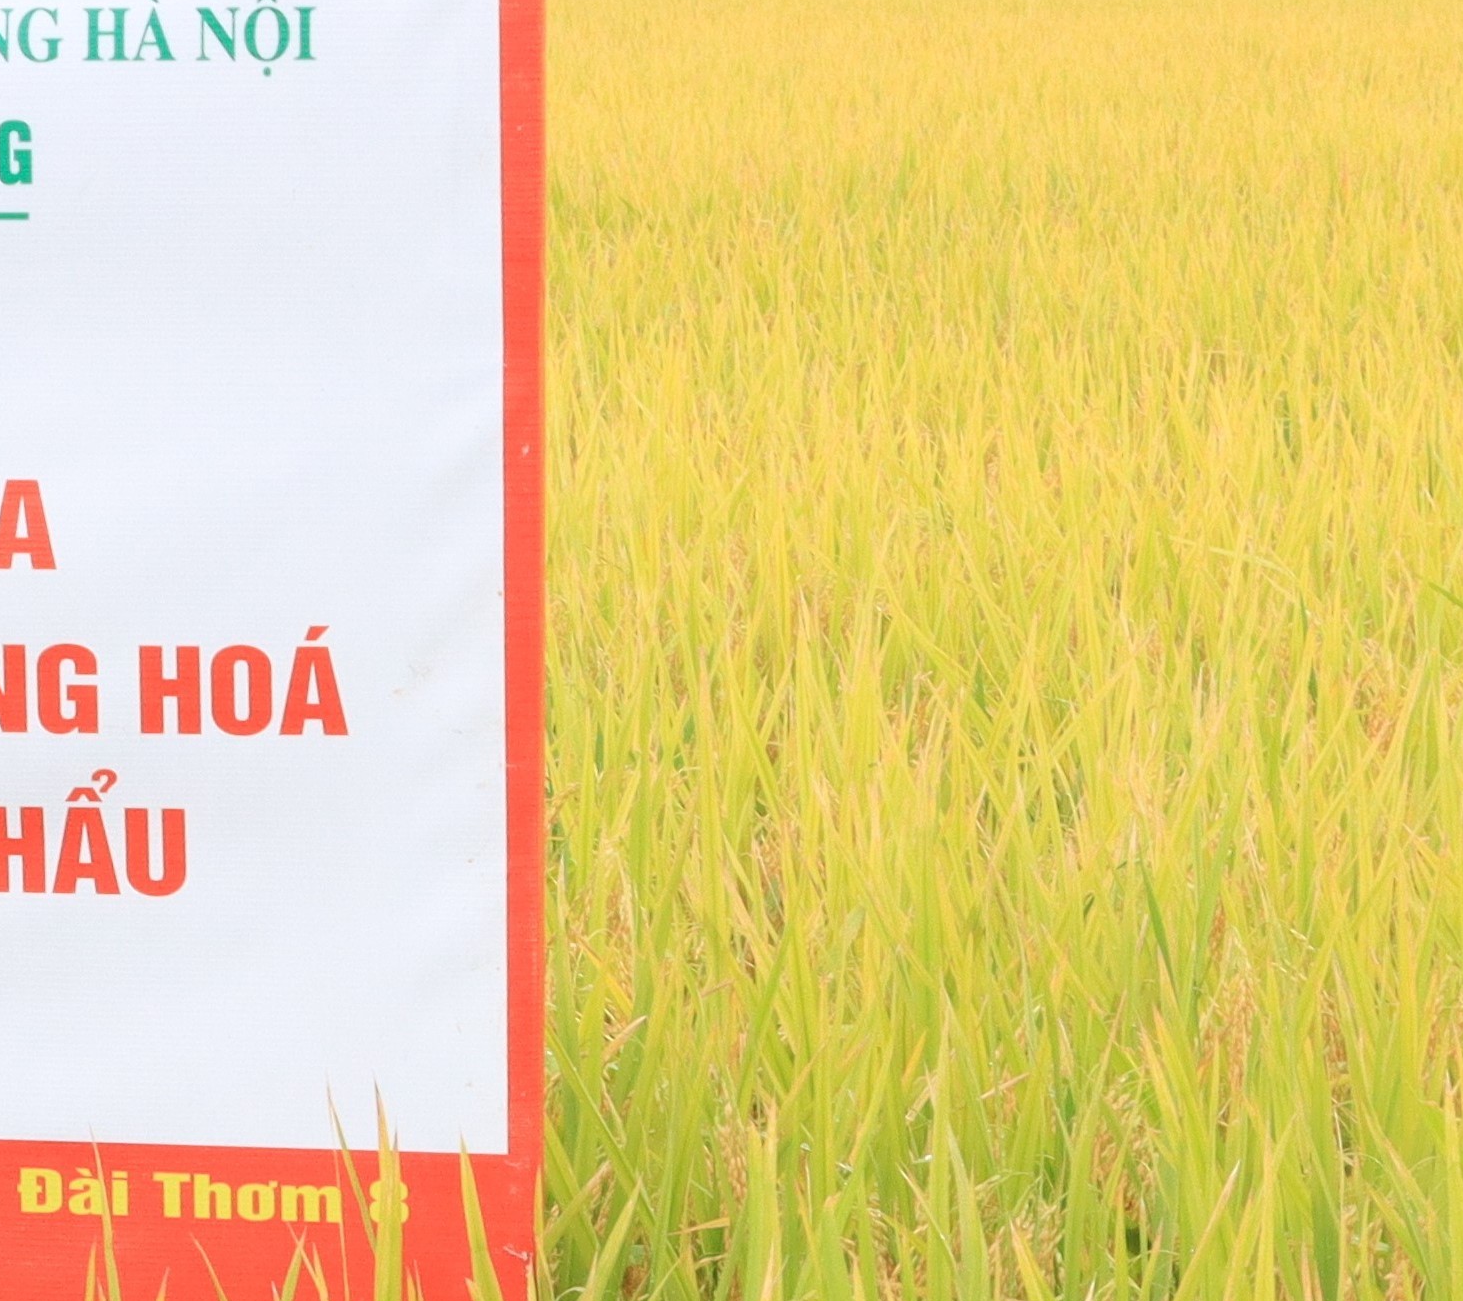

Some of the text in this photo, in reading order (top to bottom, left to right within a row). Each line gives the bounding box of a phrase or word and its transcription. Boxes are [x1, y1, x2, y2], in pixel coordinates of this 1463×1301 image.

[138, 624, 349, 737] HOÁ
[17, 1166, 129, 1217] Đài
[152, 1171, 342, 1225] Thơm
